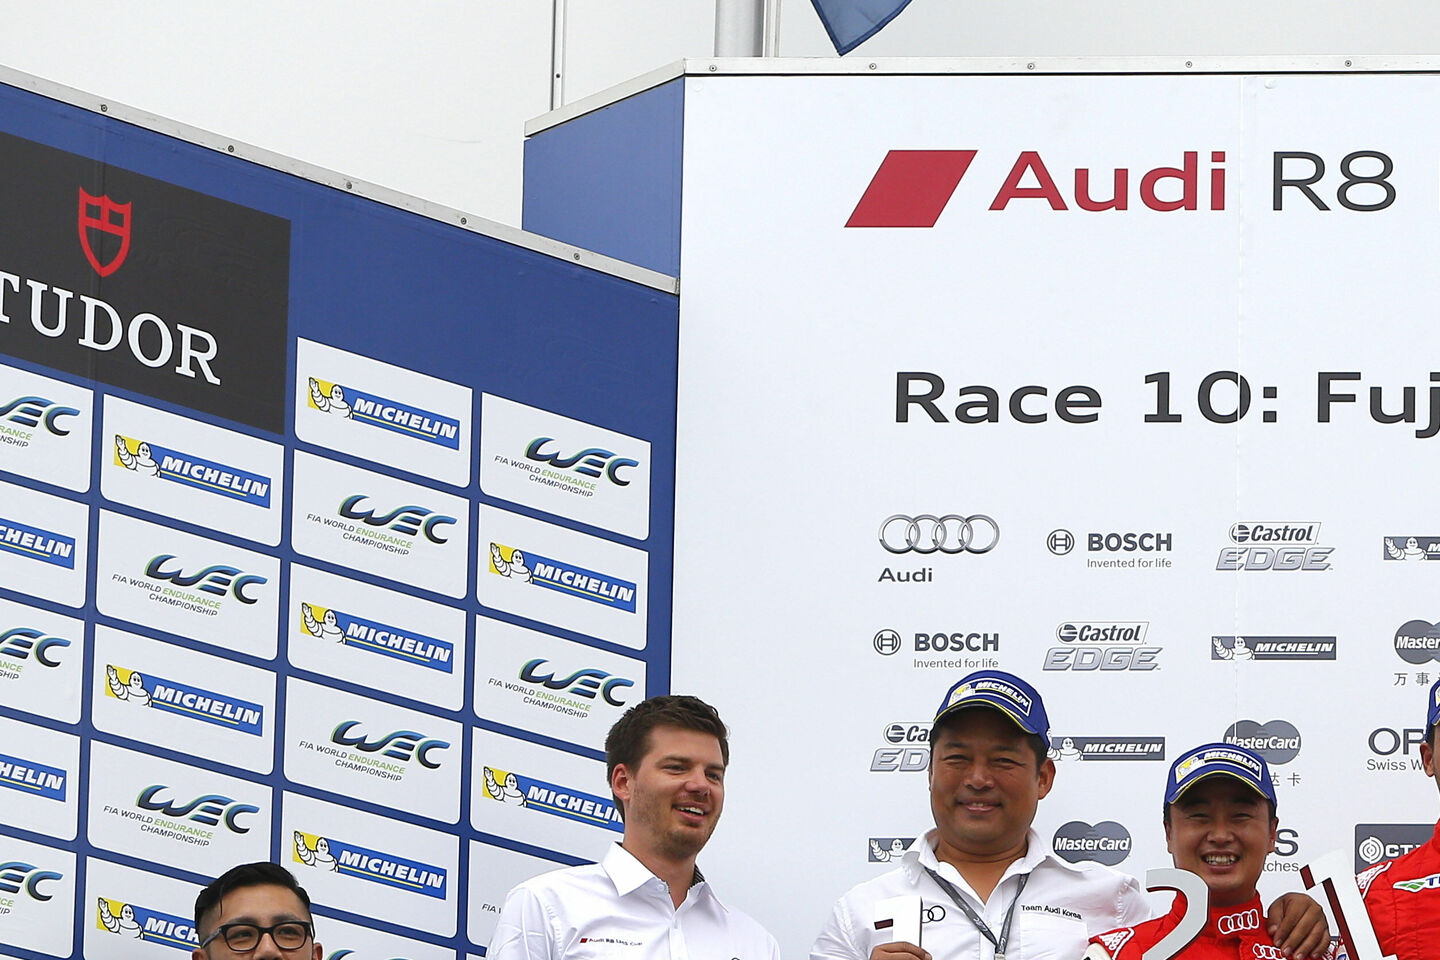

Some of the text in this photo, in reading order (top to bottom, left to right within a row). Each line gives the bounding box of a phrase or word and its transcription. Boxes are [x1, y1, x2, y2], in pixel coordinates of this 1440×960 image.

[988, 151, 1226, 212] Audi
[1273, 150, 1396, 212] R8
[896, 372, 1102, 424] Race
[1143, 371, 1277, 425] 10:
[353, 398, 457, 440] MICHELIN
[160, 455, 268, 497] MICHELIN
[494, 455, 597, 490] FIA WORLD ENDURANCE
[528, 474, 593, 497] CHAMPIONSHIP
[1087, 533, 1172, 552] BOSCH
[1250, 524, 1314, 543] Castrol
[1087, 558, 1172, 568] Invented for life
[1216, 547, 1335, 571] EDGE
[533, 563, 634, 602] MICHELIN
[878, 567, 933, 582] Audi
[112, 573, 221, 609] FIA WORLD ENDURANCE
[149, 592, 218, 618] CHAMPIONSHIP
[346, 622, 451, 663] MICHELIN
[914, 633, 999, 651] BOSCH
[1078, 624, 1141, 642] Castrol
[1043, 647, 1163, 671] EDGE
[1254, 642, 1334, 652] MICHELIN
[914, 658, 999, 668] Invented for life
[152, 685, 260, 725] MICHELIN
[976, 681, 1029, 707] MICHELIN
[299, 740, 405, 774] FIA WORLD ENDURANCE
[1085, 742, 1163, 753] MICHELIN
[335, 758, 402, 782] CHAMPIONSHIP
[1203, 751, 1260, 771] MICHELIN
[1367, 759, 1406, 770] Swiss
[1055, 836, 1130, 852] MasterCard
[338, 850, 444, 889] MICHELIN
[1044, 905, 1060, 914] Audi
[1062, 908, 1082, 920] Korea
